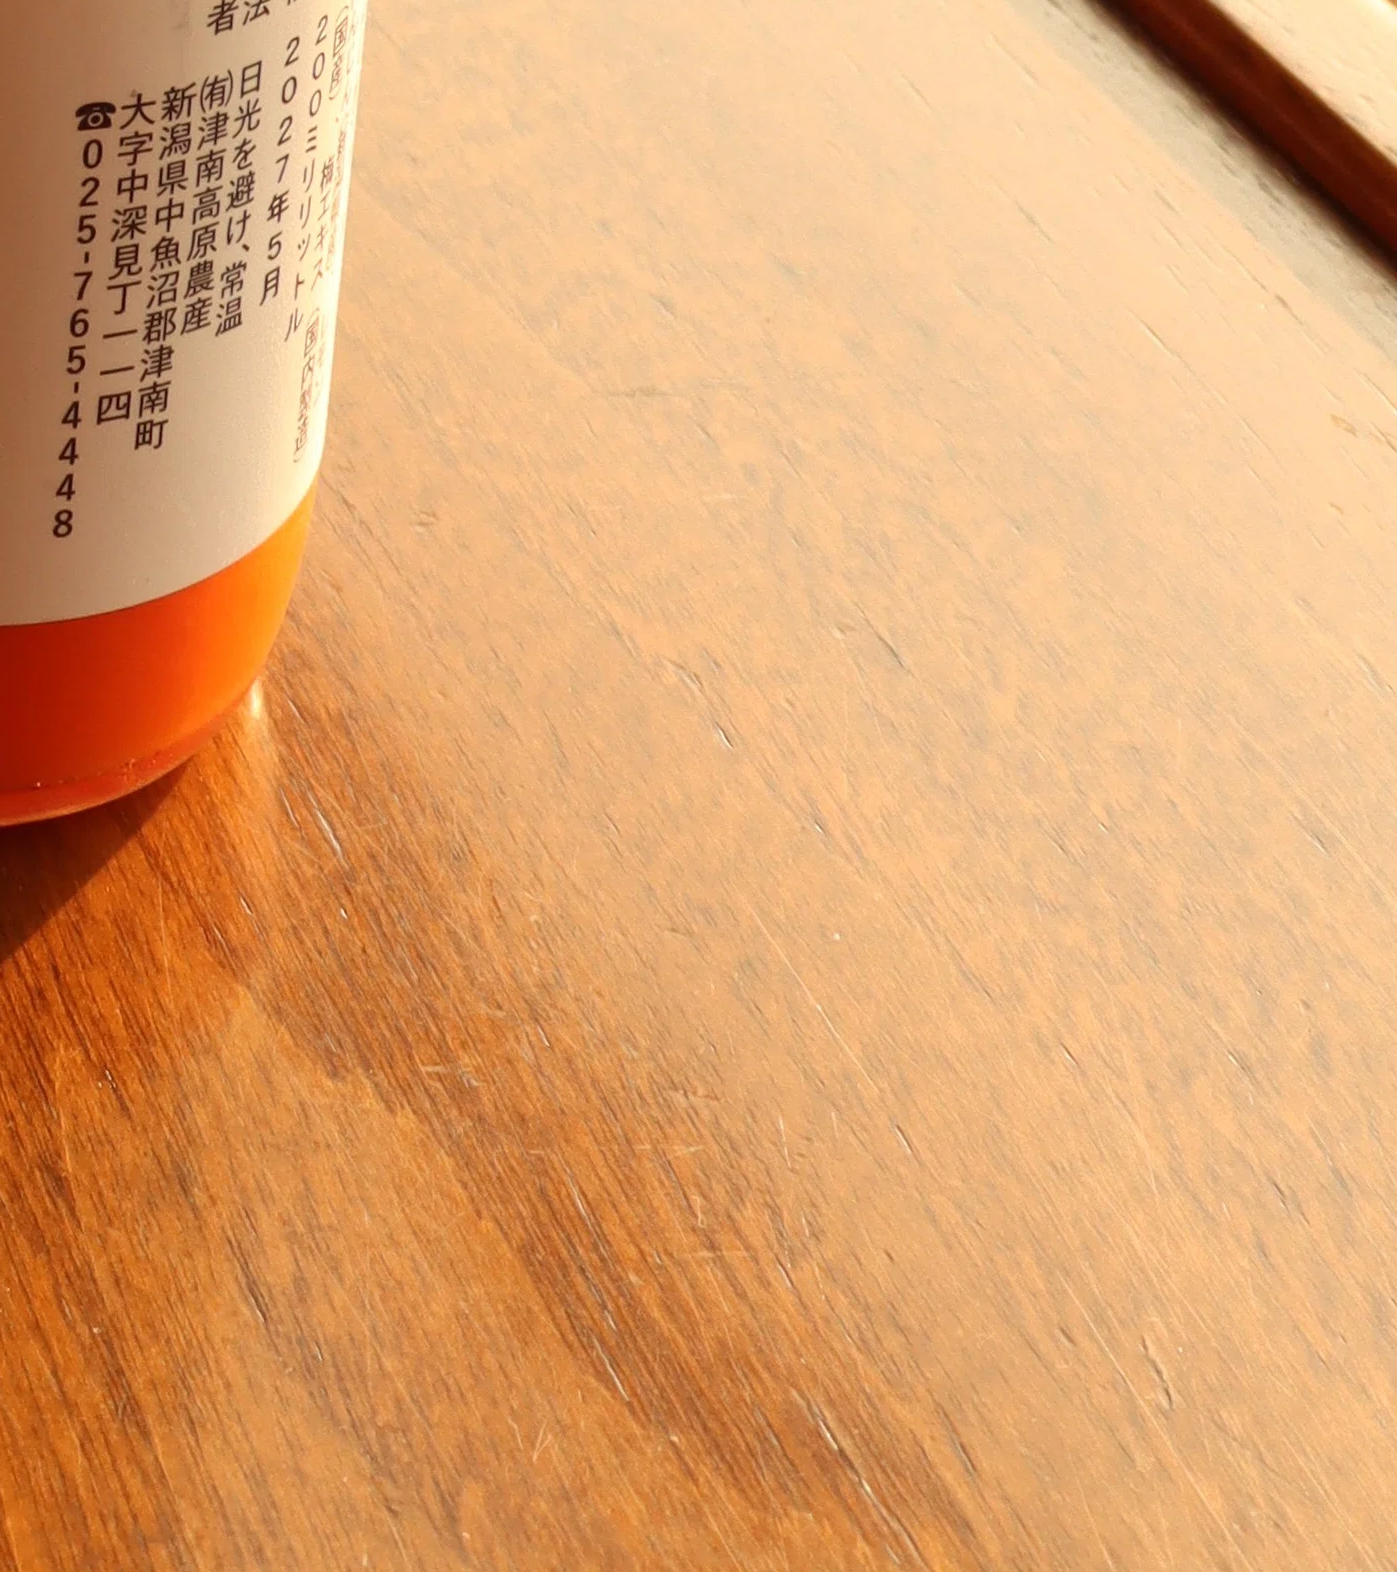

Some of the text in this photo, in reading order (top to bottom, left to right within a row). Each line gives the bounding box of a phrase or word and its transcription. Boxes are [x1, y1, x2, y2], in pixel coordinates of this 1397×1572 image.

[134, 81, 197, 450] 新潟県中魚沼郡津南町
[216, 60, 263, 336] 日光を避け、常温
[260, 36, 301, 307] 2027年5月
[285, 14, 328, 343] 200ミリリットル
